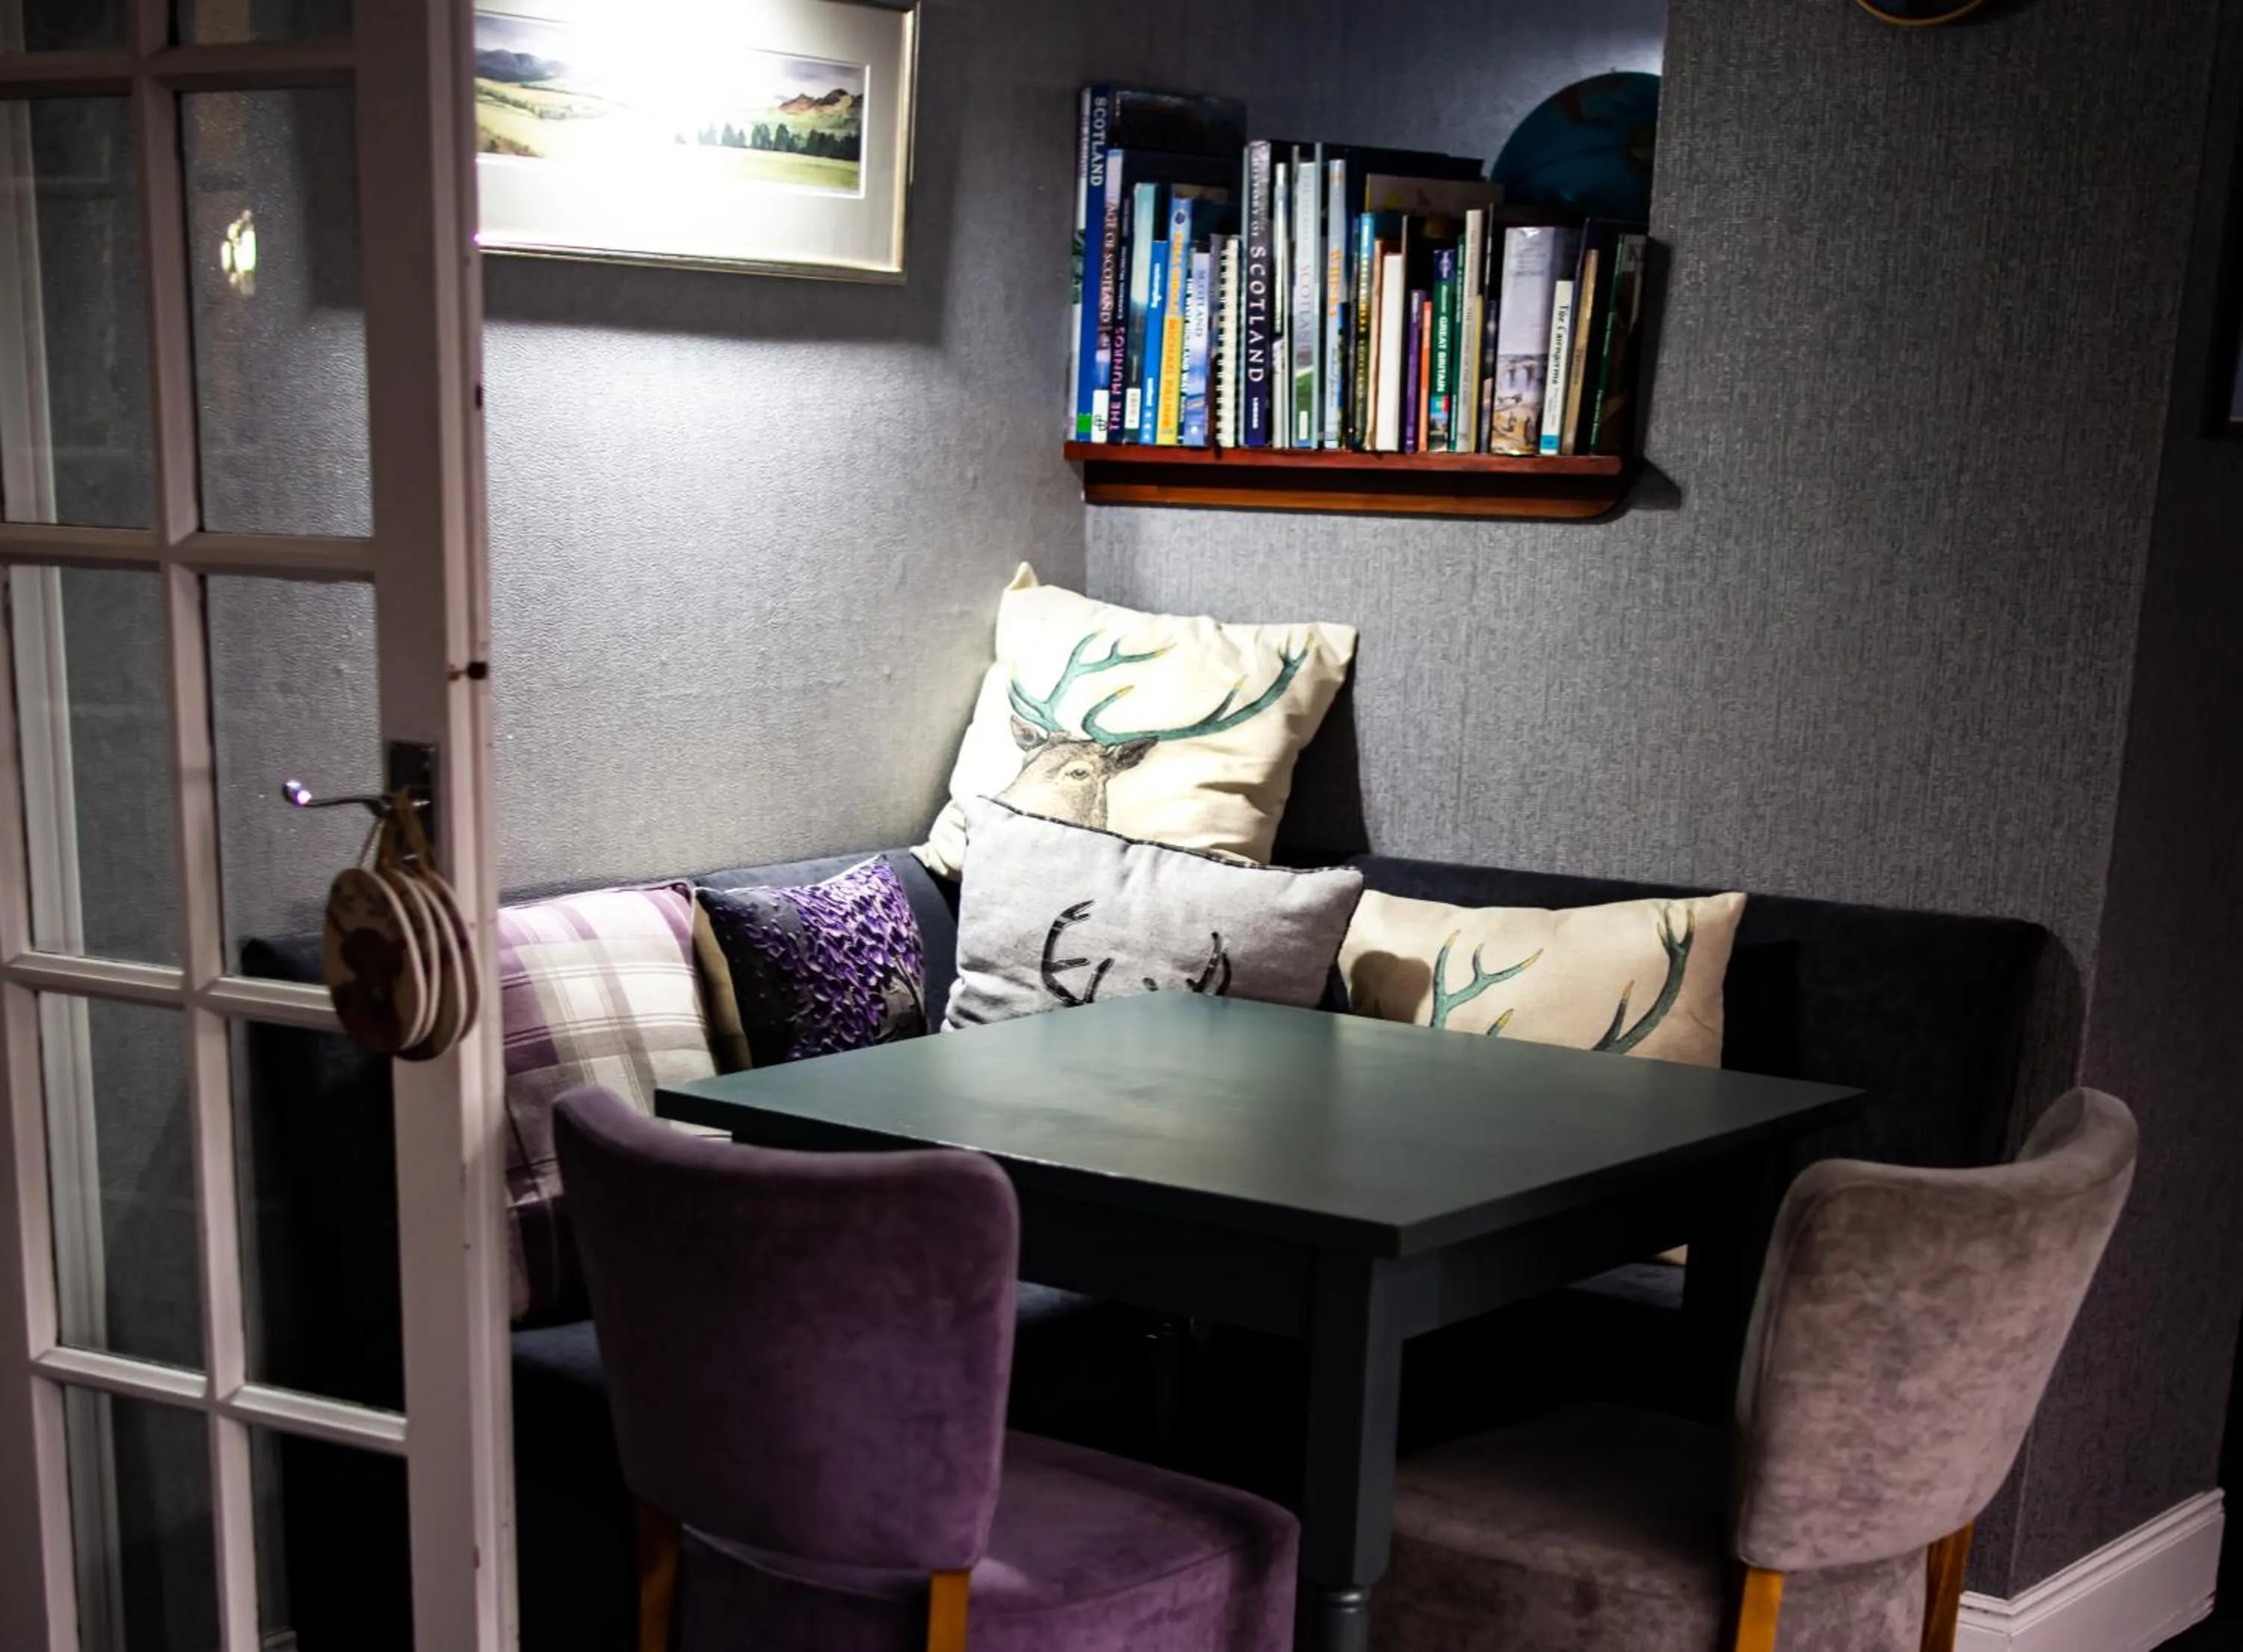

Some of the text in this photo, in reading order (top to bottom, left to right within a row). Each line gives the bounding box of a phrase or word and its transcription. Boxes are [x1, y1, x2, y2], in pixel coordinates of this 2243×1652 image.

[1089, 96, 1108, 188] SCOTLAND
[1100, 253, 1114, 323] SCOTLAND
[1195, 269, 1207, 338] SCOTLAND
[1248, 245, 1267, 383] SCOTLAND
[1557, 304, 1569, 323] The
[1166, 318, 1179, 375] MICHAEL
[1438, 315, 1449, 349] GREAT
[1110, 327, 1126, 431] THE MUNROS
[1436, 351, 1447, 392] BRITAIN
